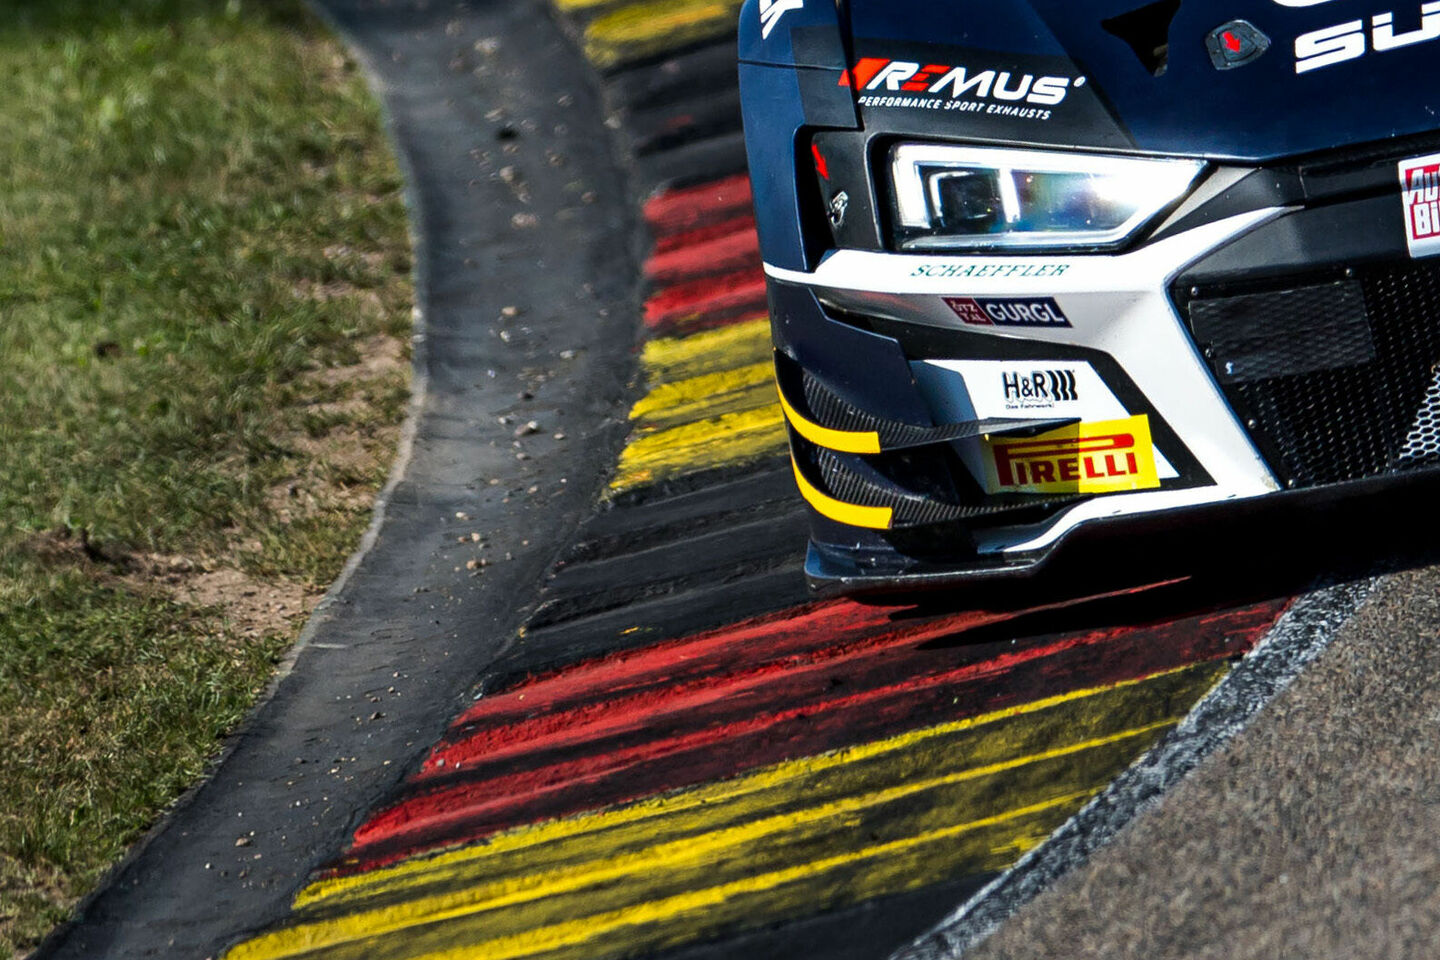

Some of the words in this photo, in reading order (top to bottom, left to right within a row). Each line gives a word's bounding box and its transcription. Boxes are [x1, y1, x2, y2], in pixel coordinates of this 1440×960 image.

[866, 61, 1070, 106] REMUS
[857, 95, 943, 111] PERFORMANCE
[943, 100, 985, 113] SPORT
[986, 104, 1052, 121] EXHAUSTS
[910, 264, 1070, 277] SCHAEFFLER
[985, 303, 1066, 323] GURGL
[1002, 371, 1050, 401] H&R
[993, 433, 1138, 486] PIRELLI
